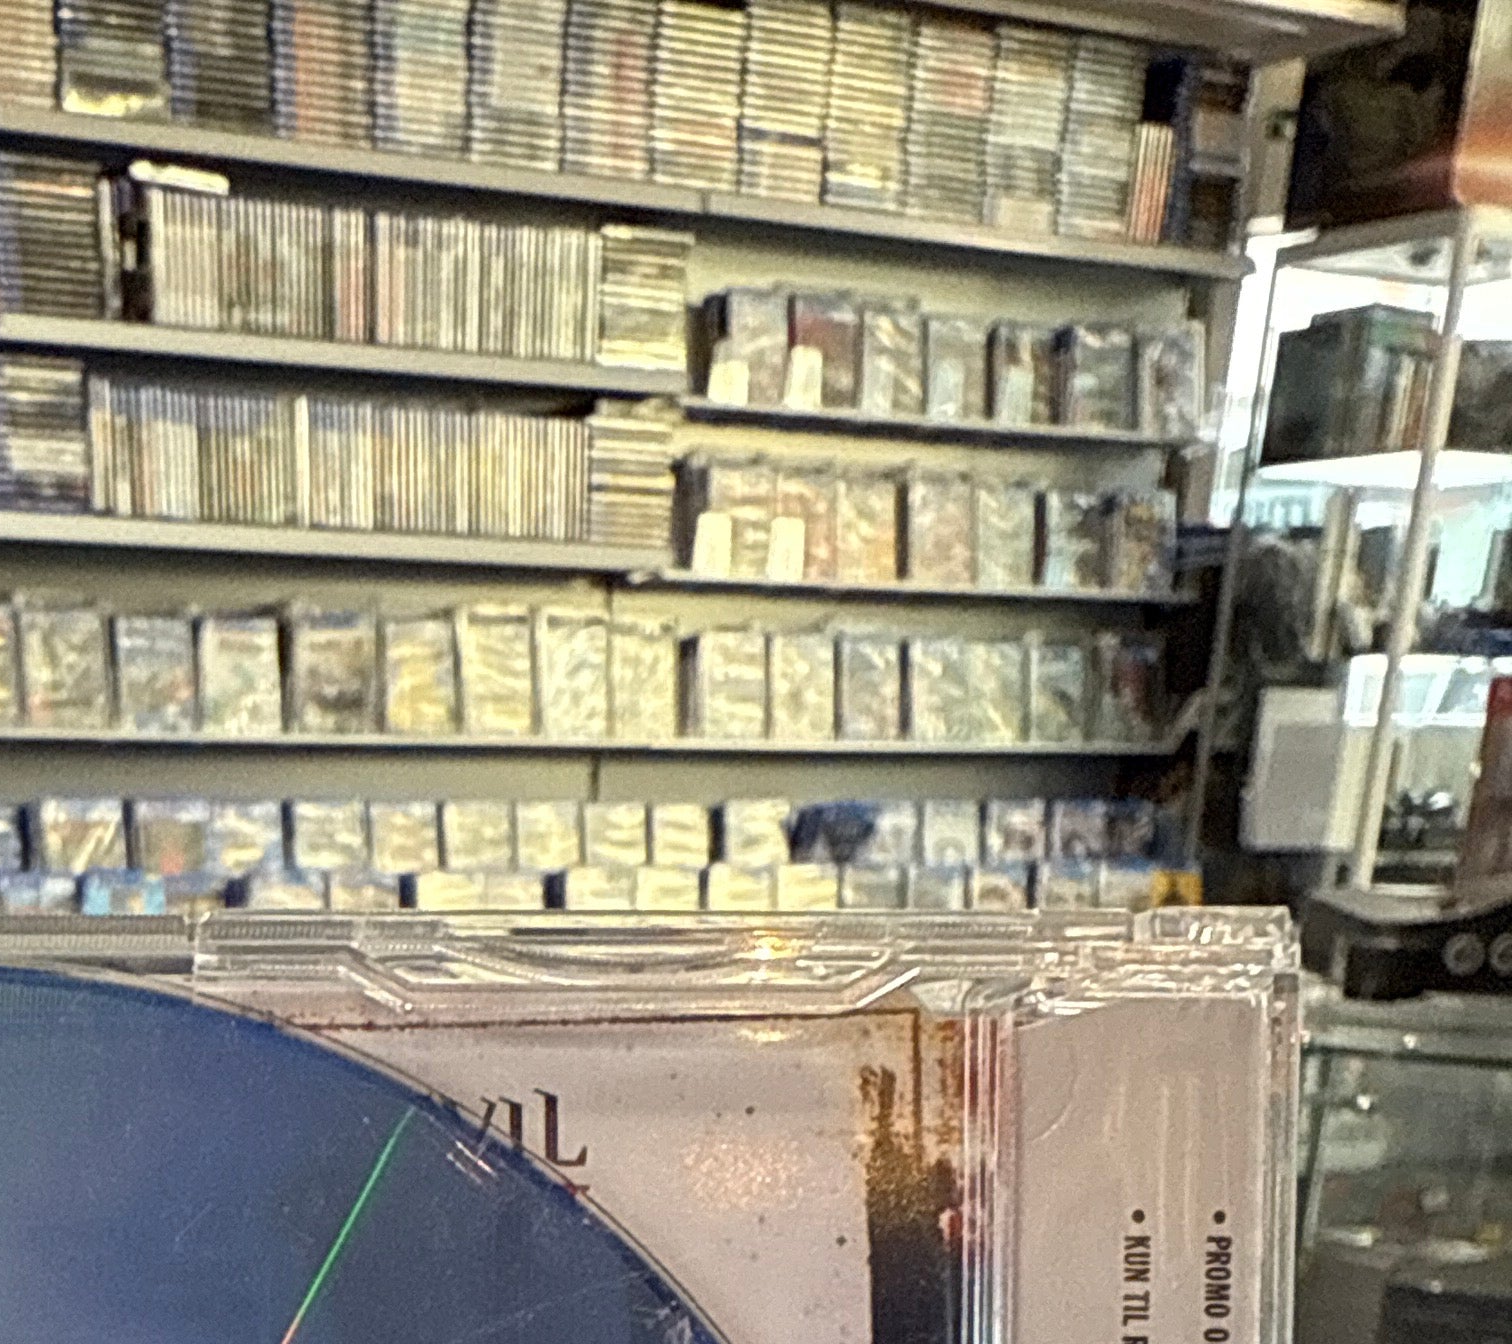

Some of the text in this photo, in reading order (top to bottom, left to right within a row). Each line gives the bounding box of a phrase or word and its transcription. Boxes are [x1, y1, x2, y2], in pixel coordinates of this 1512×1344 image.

[1124, 1235, 1151, 1282] KUN
[1204, 1235, 1232, 1318] PROMO
[1122, 1290, 1150, 1326] TIL
